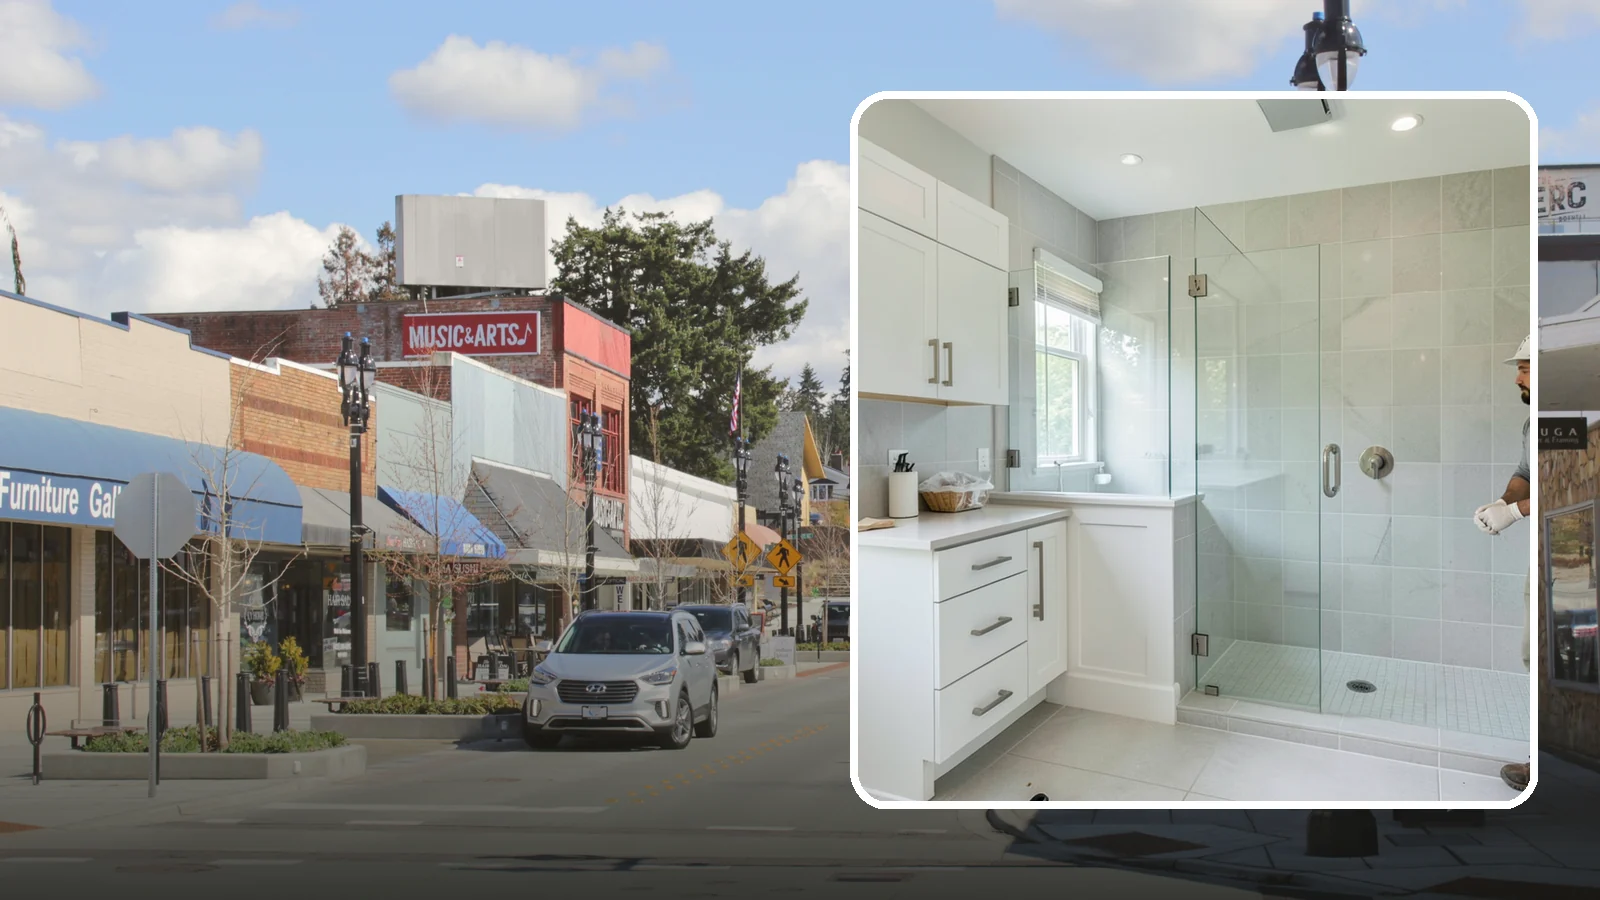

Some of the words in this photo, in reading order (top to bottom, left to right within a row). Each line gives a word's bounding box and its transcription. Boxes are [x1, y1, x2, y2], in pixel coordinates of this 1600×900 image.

[408, 323, 519, 349] MUSIC&ARTS
[0, 471, 79, 515] Furniture
[89, 482, 122, 519] Gal
